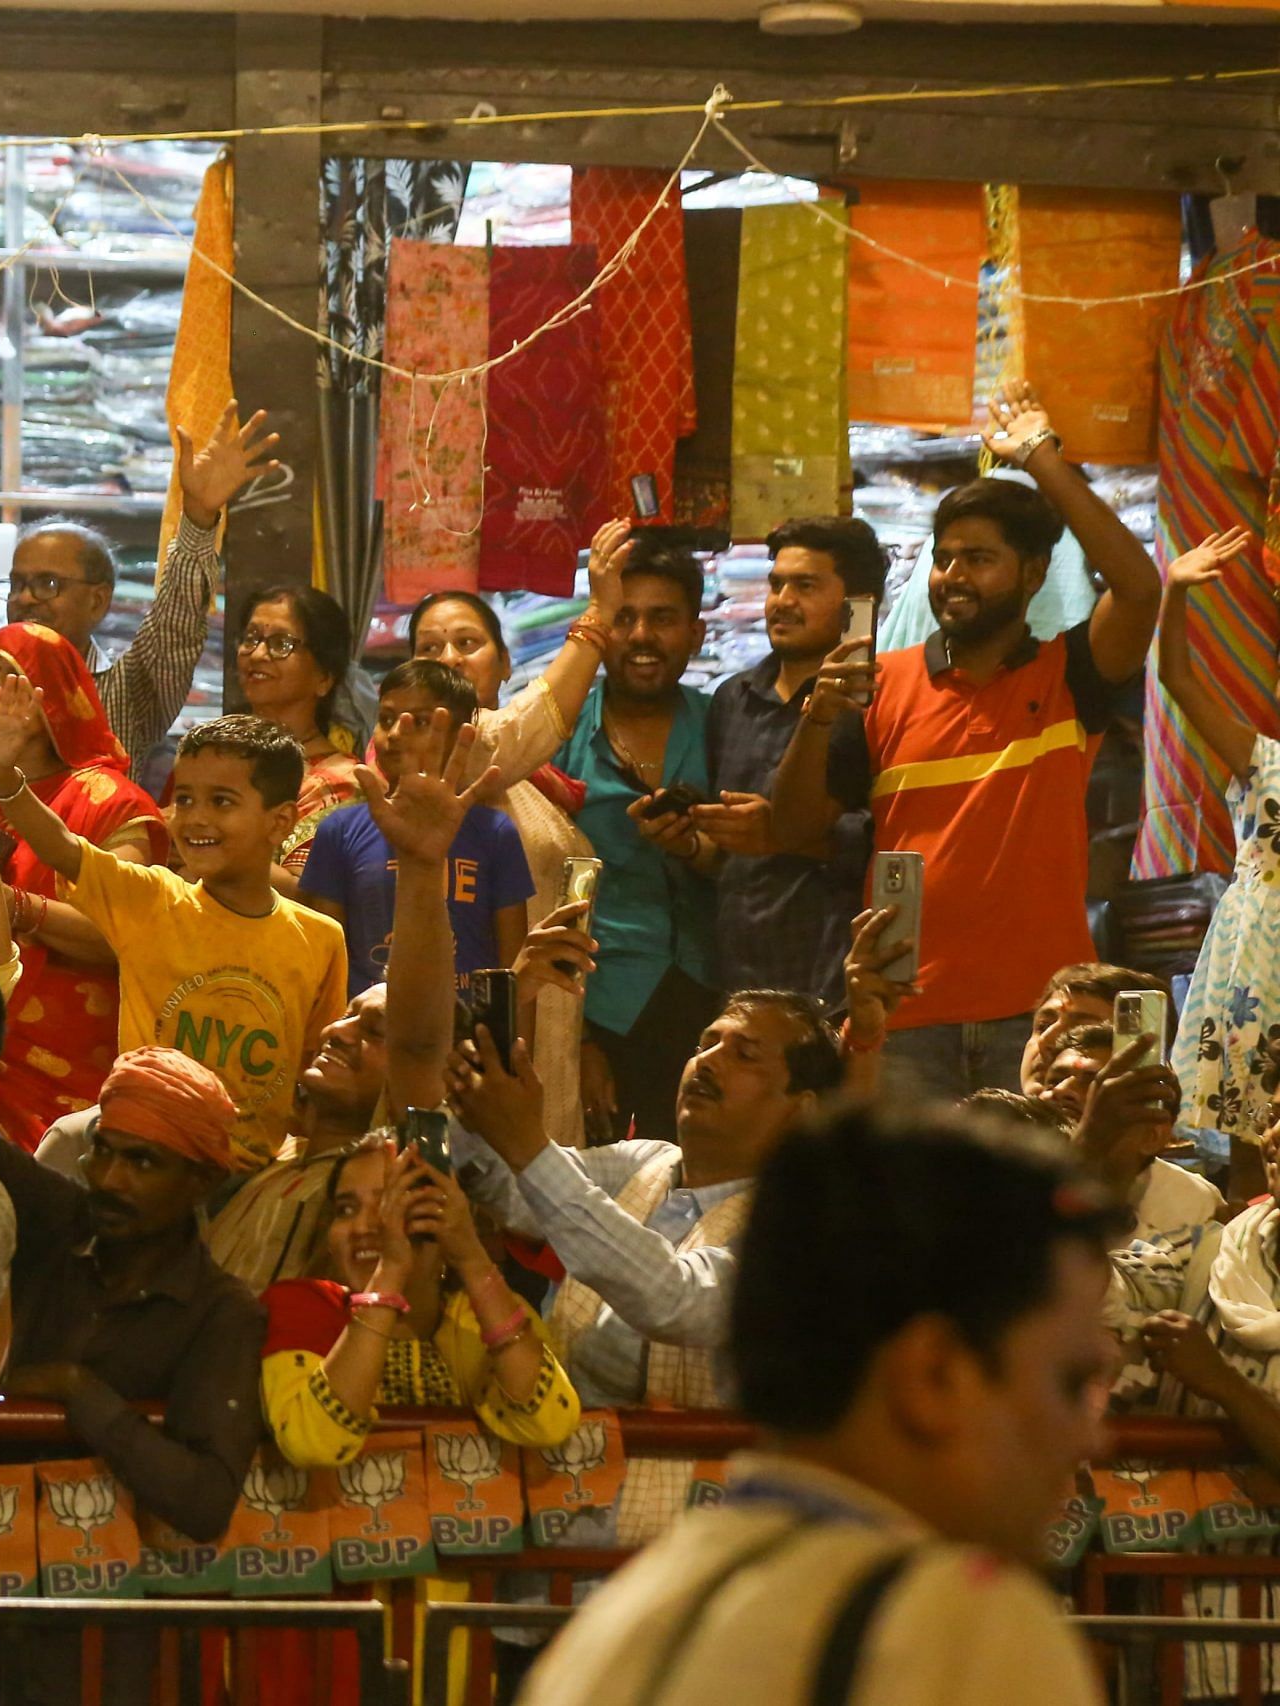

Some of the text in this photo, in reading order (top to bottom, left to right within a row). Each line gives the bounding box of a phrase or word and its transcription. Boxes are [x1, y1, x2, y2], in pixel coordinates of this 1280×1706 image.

[160, 974, 205, 1019] UNITED
[174, 1010, 279, 1077] NYC
[430, 1514, 513, 1546] BJP
[1107, 1508, 1189, 1546] BJP
[139, 1543, 218, 1578] BJP
[236, 1544, 320, 1578] BJP
[337, 1535, 421, 1569] BJP
[49, 1559, 129, 1596] BJP
